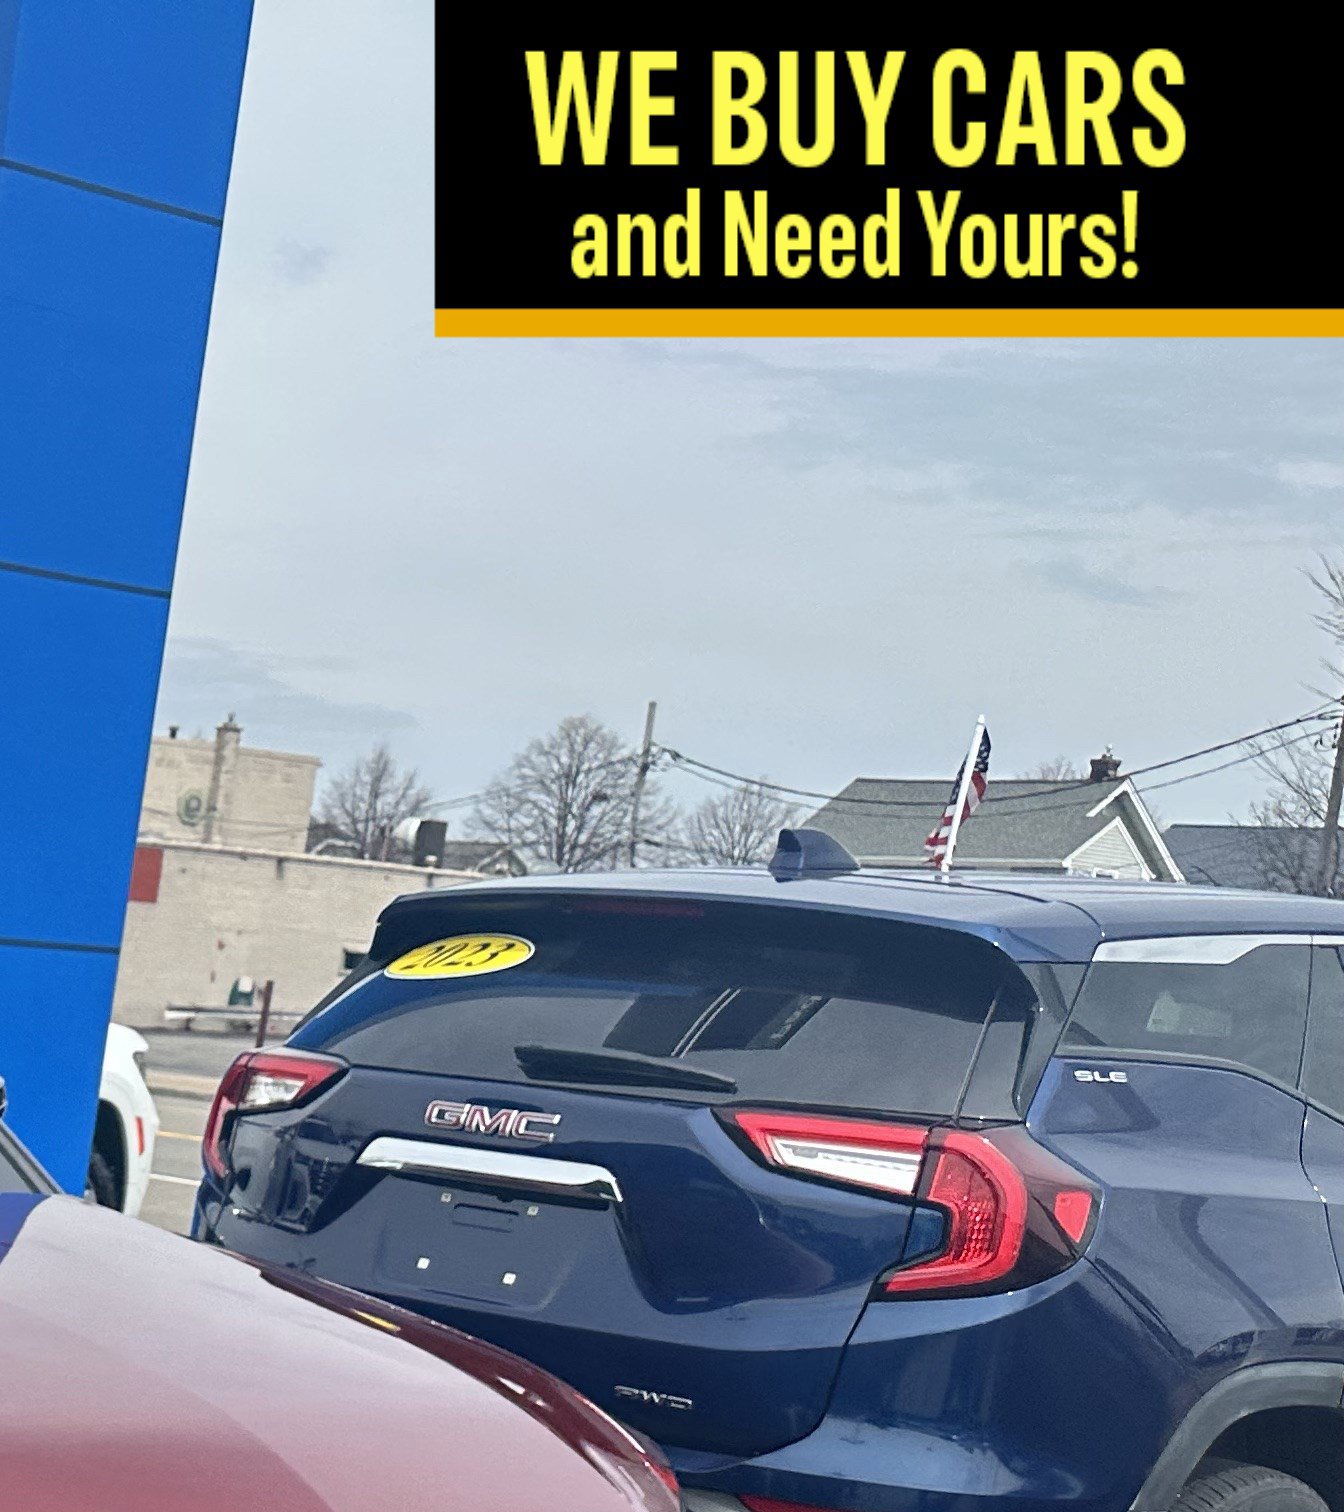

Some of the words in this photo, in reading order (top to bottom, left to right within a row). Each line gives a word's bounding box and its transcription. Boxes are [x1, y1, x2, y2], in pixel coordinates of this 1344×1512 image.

[399, 941, 517, 971] 2023
[1073, 1069, 1128, 1083] SLE
[424, 1099, 562, 1143] GMC
